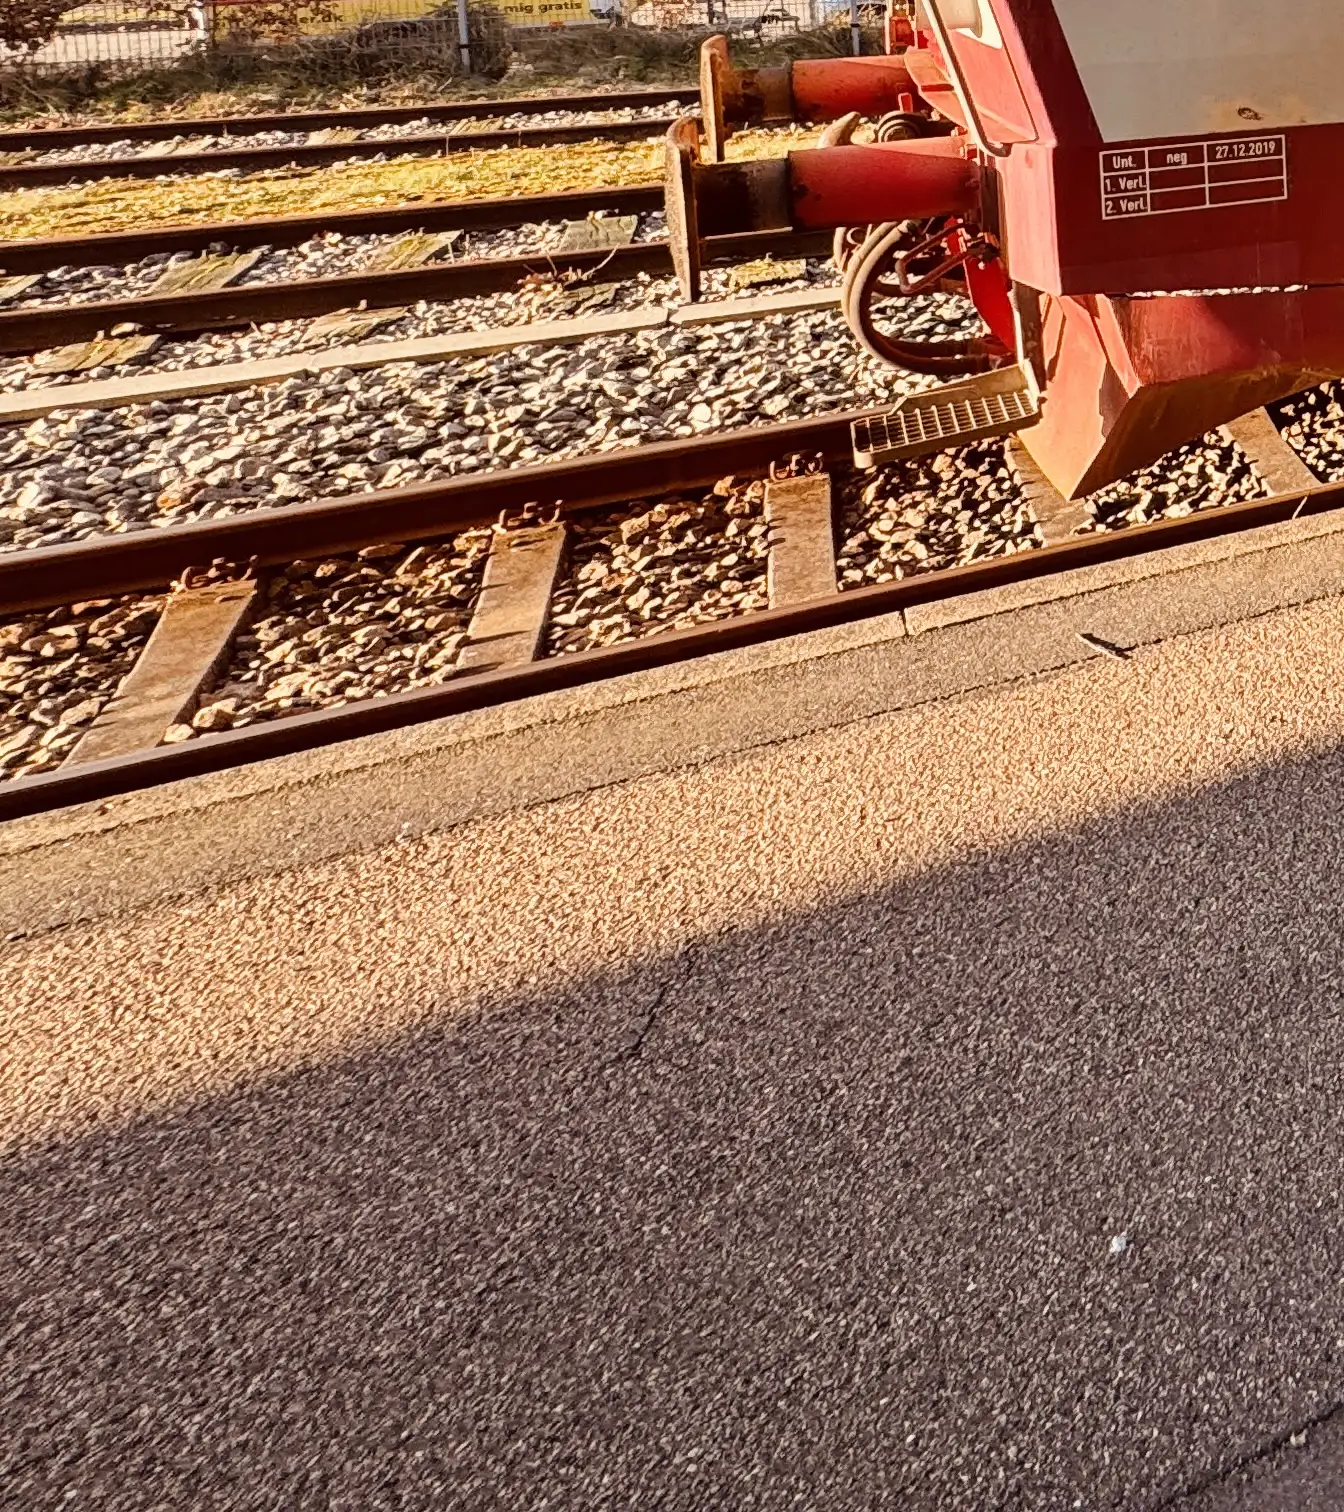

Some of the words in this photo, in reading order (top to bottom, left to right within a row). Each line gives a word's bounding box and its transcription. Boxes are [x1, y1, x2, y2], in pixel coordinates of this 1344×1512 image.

[504, 4, 534, 14] mig
[538, 1, 583, 13] gratis
[1112, 155, 1137, 169] Unt.
[1166, 152, 1188, 165] neg
[1215, 141, 1276, 159] 27.12.2019
[1105, 178, 1116, 191] 1.
[1105, 201, 1117, 213] 2.
